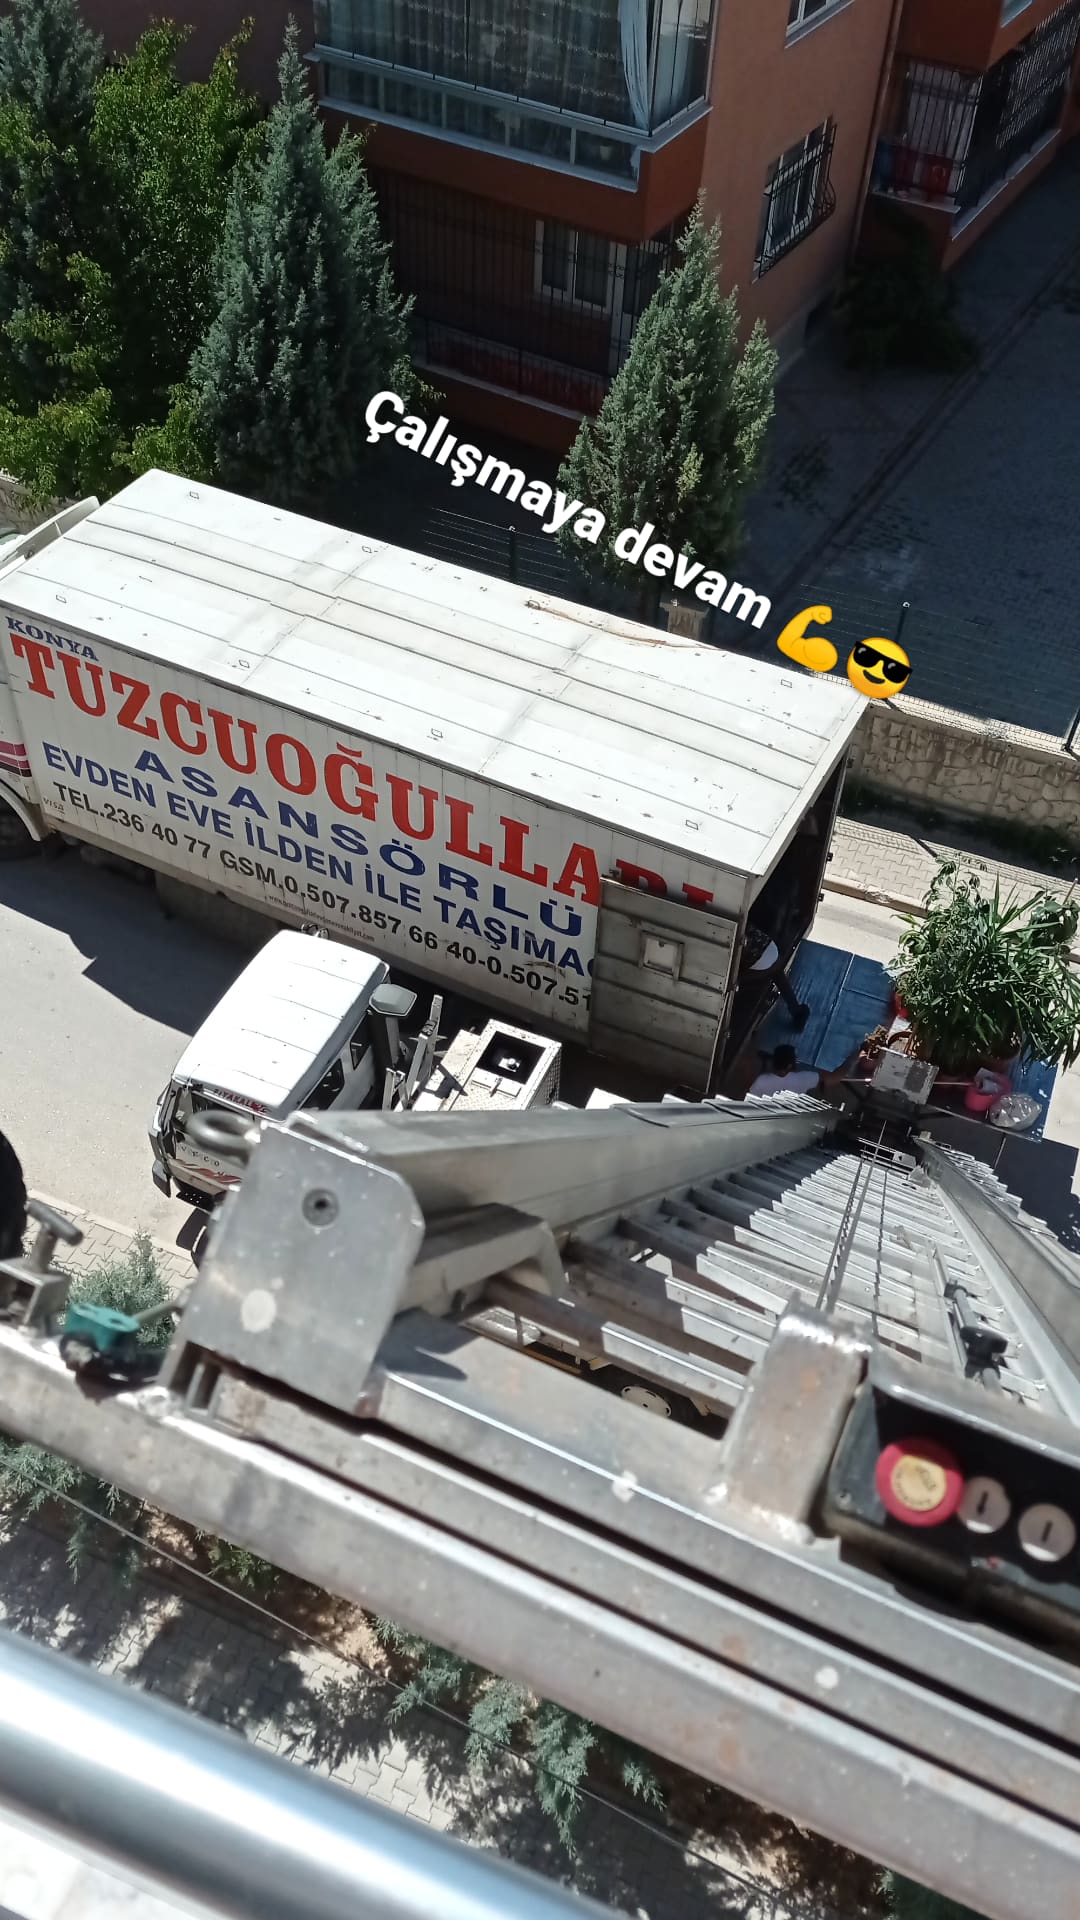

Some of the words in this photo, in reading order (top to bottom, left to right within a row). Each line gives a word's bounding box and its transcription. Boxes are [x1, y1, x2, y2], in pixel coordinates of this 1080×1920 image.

[5, 616, 99, 661] KONYA
[42, 741, 156, 808] EVDEN
[166, 791, 234, 838] EVE
[244, 817, 354, 886] İLDEN
[364, 863, 422, 912] İLE
[53, 781, 144, 832] TEL.236
[151, 823, 178, 846] 40
[183, 833, 211, 858] 77
[408, 924, 438, 950] 66
[134, 749, 582, 937] ASANSÖRLÜ
